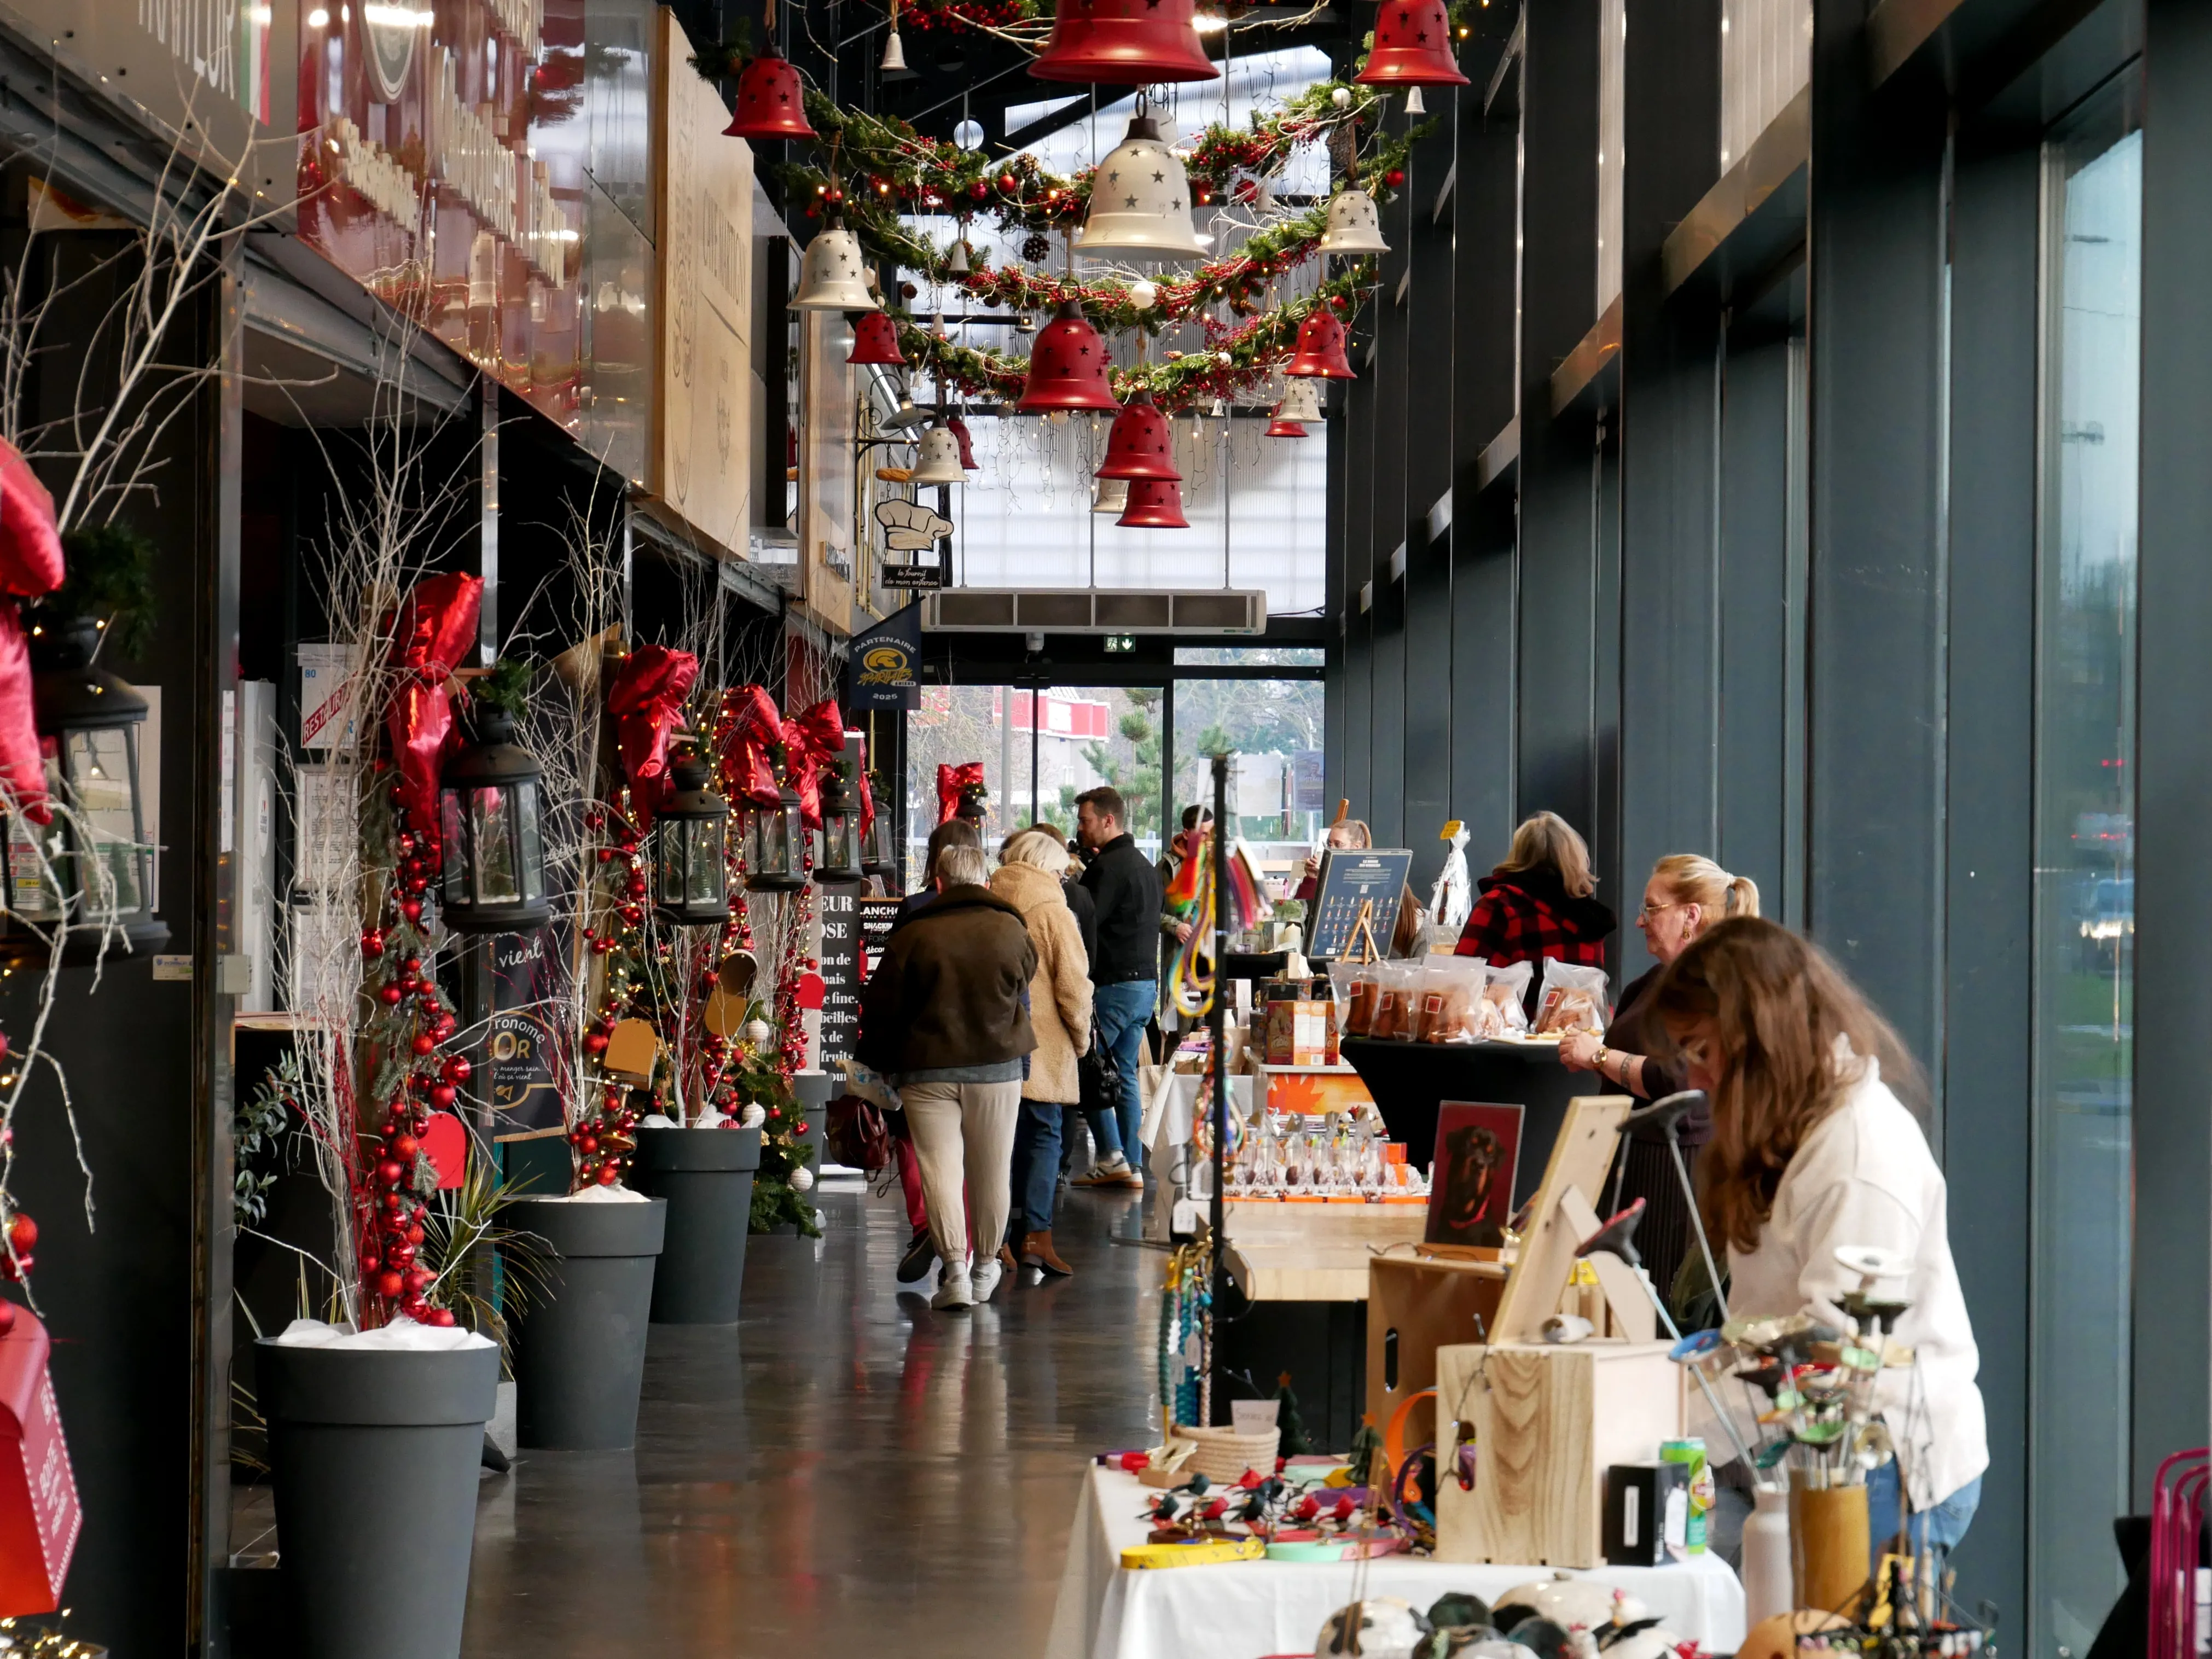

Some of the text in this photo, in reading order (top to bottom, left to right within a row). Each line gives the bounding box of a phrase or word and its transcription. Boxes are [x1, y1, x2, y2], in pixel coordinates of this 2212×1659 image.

[912, 577, 938, 586] enfance
[854, 636, 916, 654] PARTENAIRE
[305, 670, 316, 678] 80
[860, 906, 898, 915] ANCH
[499, 935, 542, 968] vient
[837, 953, 851, 965] de
[832, 992, 858, 1004] fine.
[495, 1019, 545, 1044] ronome
[829, 1031, 843, 1043] de
[821, 1050, 854, 1062] fruits
[500, 1066, 524, 1074] manger
[516, 1072, 532, 1080] vient
